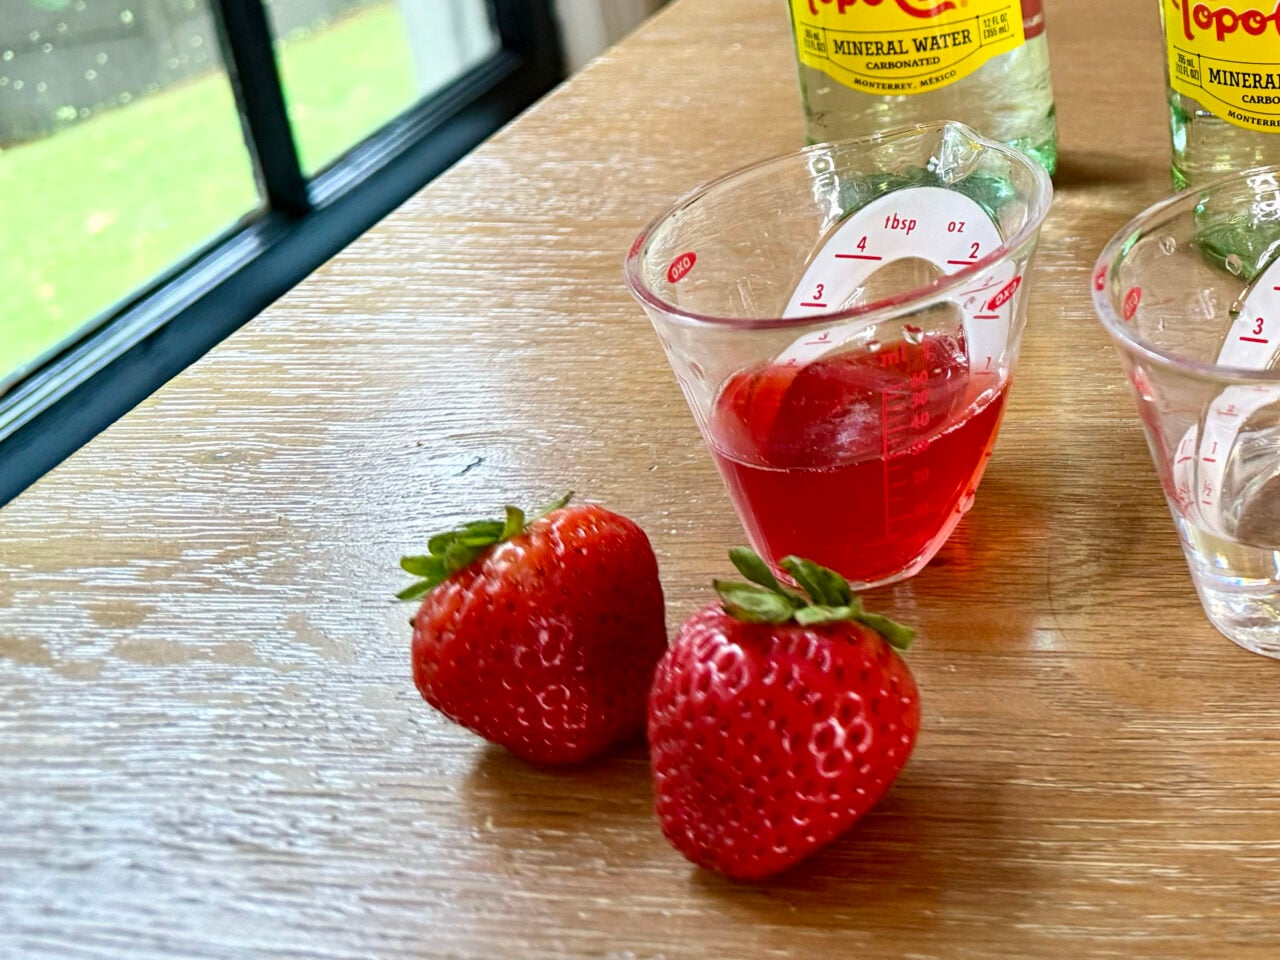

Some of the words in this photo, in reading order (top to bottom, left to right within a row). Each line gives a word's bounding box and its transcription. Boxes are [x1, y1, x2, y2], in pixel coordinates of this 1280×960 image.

[833, 38, 909, 57] MINERAL
[912, 28, 973, 53] WATER
[866, 56, 941, 71] CARBONATED
[920, 69, 957, 88] MÉXICO
[884, 213, 917, 235] tbsp
[947, 220, 966, 233] oz
[856, 235, 868, 253] 4
[968, 242, 980, 259] 2
[671, 256, 691, 280] OXO
[812, 283, 825, 300] 3
[1252, 316, 1265, 336] 3
